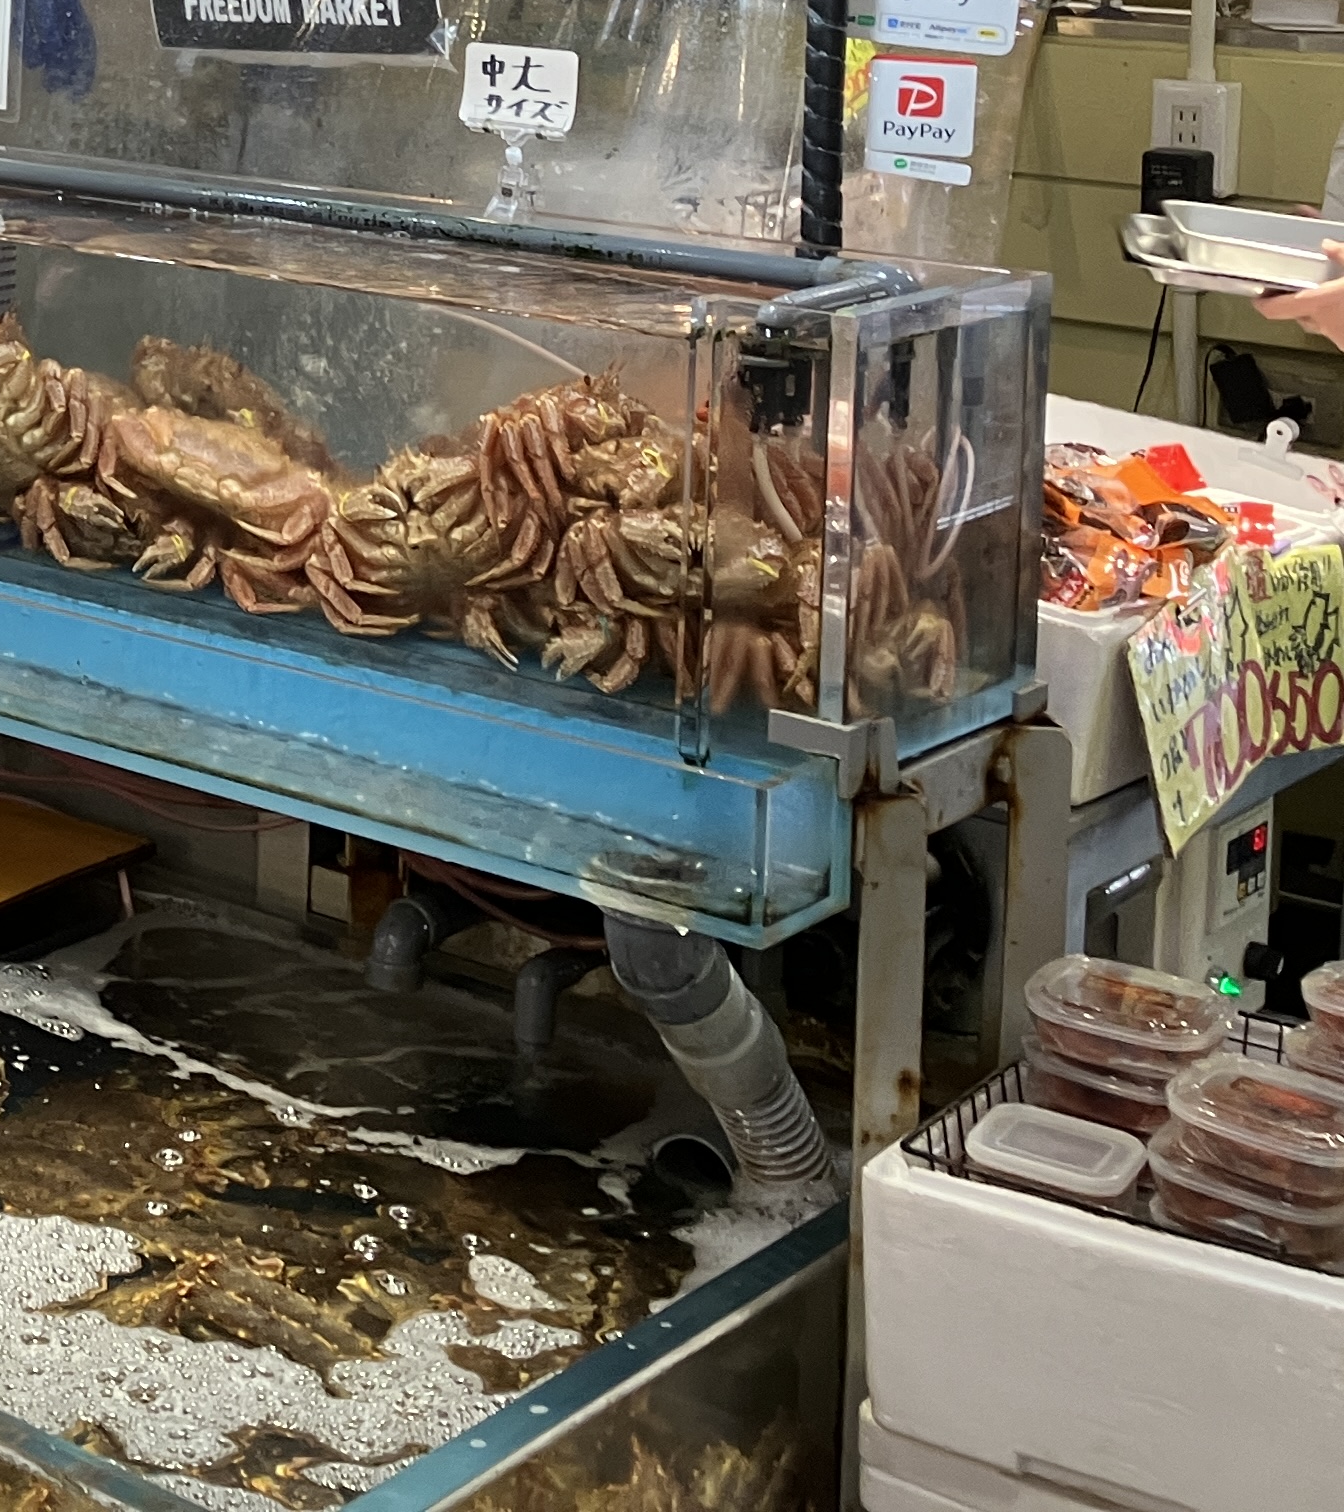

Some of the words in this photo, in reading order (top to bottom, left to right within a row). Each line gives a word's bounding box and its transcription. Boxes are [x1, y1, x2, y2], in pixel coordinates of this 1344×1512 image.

[483, 91, 570, 123] サイズ
[883, 119, 956, 143] PayPay
